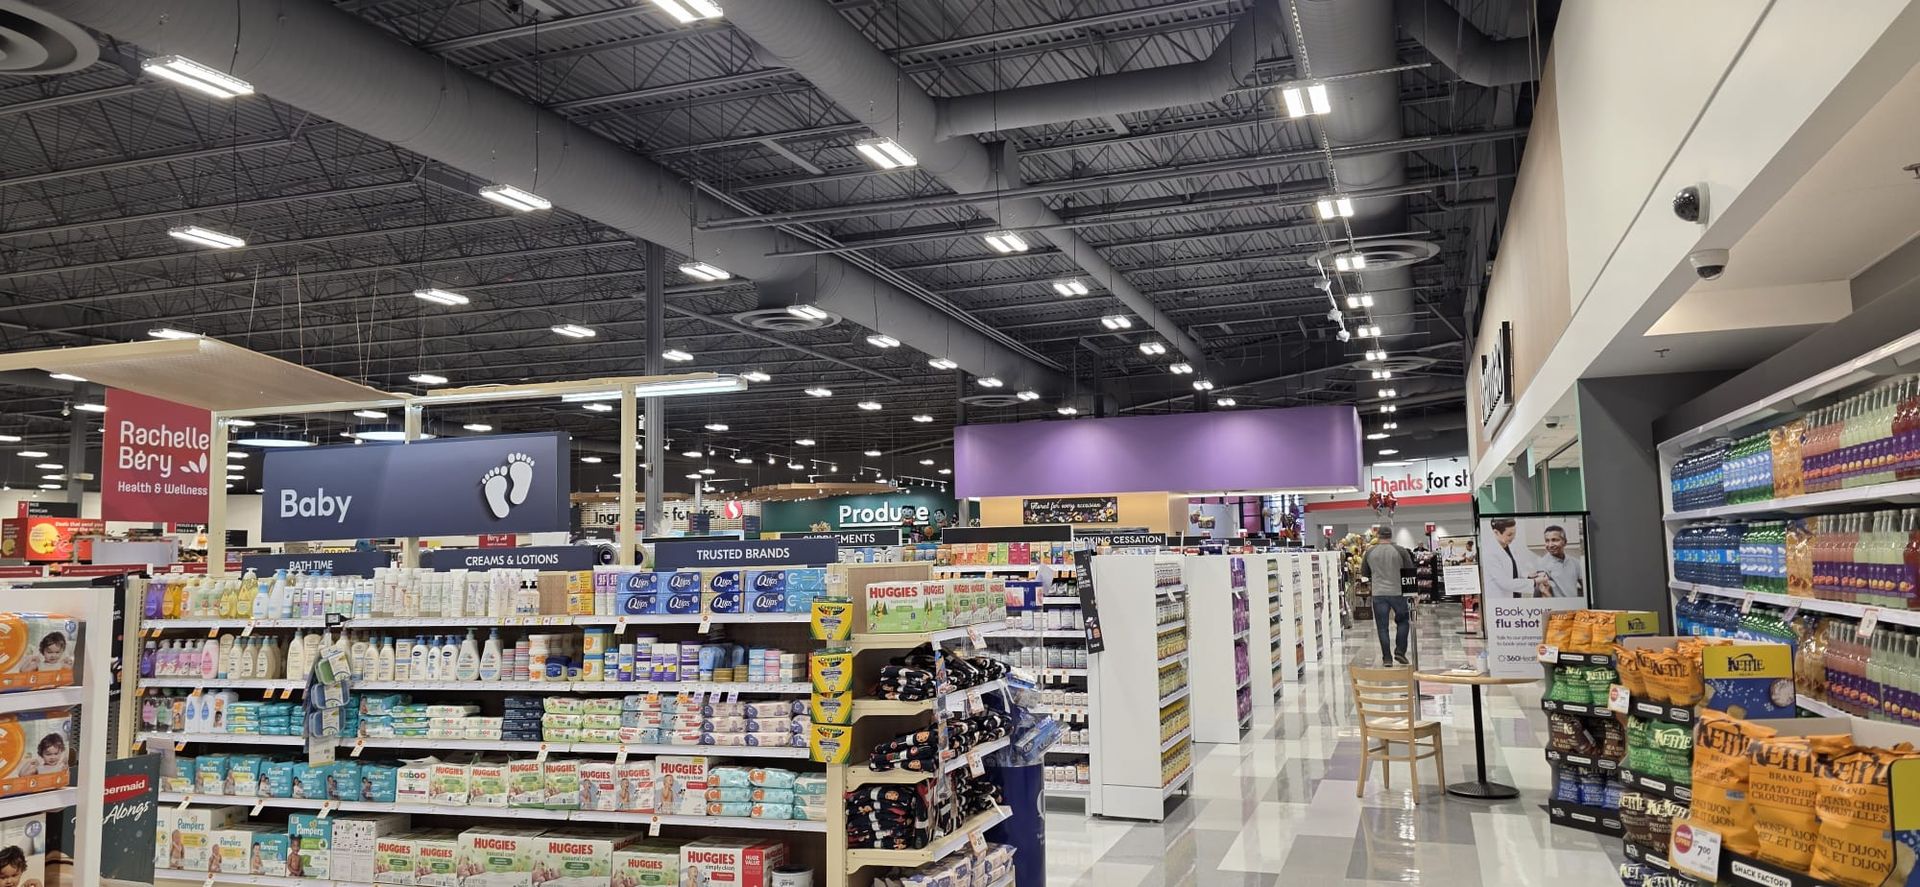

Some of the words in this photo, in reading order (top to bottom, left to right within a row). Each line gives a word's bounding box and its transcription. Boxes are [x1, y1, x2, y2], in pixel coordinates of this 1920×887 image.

[120, 420, 210, 451] Rachelle
[1371, 474, 1423, 493] Thanks
[1427, 471, 1450, 489] for
[118, 481, 153, 493] Health
[155, 481, 162, 493] &
[165, 483, 209, 496] Wellness
[280, 488, 353, 523] Baby
[839, 502, 929, 523] Produe
[1072, 536, 1112, 544] SMOKING
[1113, 535, 1162, 544] CESSATION
[696, 548, 743, 560] TRUSTED
[744, 547, 790, 559] BRANDS
[289, 561, 312, 571] BATH
[313, 560, 333, 571] TIME
[465, 556, 505, 567] CREAMS
[506, 556, 513, 566] &
[515, 554, 559, 566] LOTIONS
[1401, 576, 1416, 585] EXIT
[869, 587, 918, 599] HUGGIES
[923, 585, 944, 596] HUGGIES
[1495, 606, 1524, 617] Book
[1496, 619, 1511, 628] flu
[1514, 618, 1540, 629] shot
[1652, 657, 1690, 678] KETTLE
[1727, 653, 1765, 672] KETTLE
[1655, 728, 1692, 750] KETTLE
[399, 770, 426, 779] caboo
[435, 766, 464, 776] HUGGIES
[471, 767, 501, 777] HUGGIES
[509, 763, 539, 774] HUGGIES
[545, 763, 576, 774] HUGGIES
[580, 770, 611, 779] HUGGIES
[617, 769, 650, 778] HUGGIES
[661, 763, 703, 775] HUGGIES
[1768, 772, 1803, 784] BRAND
[1750, 782, 1790, 795] POTATO
[1831, 784, 1867, 796] BRAND
[1853, 799, 1889, 813] CHIPS
[103, 800, 151, 825] Alongs
[177, 818, 205, 832] Pampers
[296, 823, 324, 836] Pampers
[220, 837, 241, 848] Pampers
[260, 842, 279, 850] Pampers
[378, 842, 411, 854] HUGGIES
[474, 838, 517, 851] HUGGIES
[549, 842, 594, 855] HUGGIES
[1776, 837, 1790, 848] ET
[420, 847, 453, 858] HUGGIES
[1848, 842, 1888, 860] DIJON
[628, 858, 663, 869] HUGGIES
[687, 850, 736, 865] HUGGIES
[1832, 852, 1846, 864] ET
[1852, 855, 1891, 874] DIJON
[705, 864, 722, 872] simply
[1734, 864, 1756, 878] SNACK
[1756, 872, 1789, 887] FACTORY
